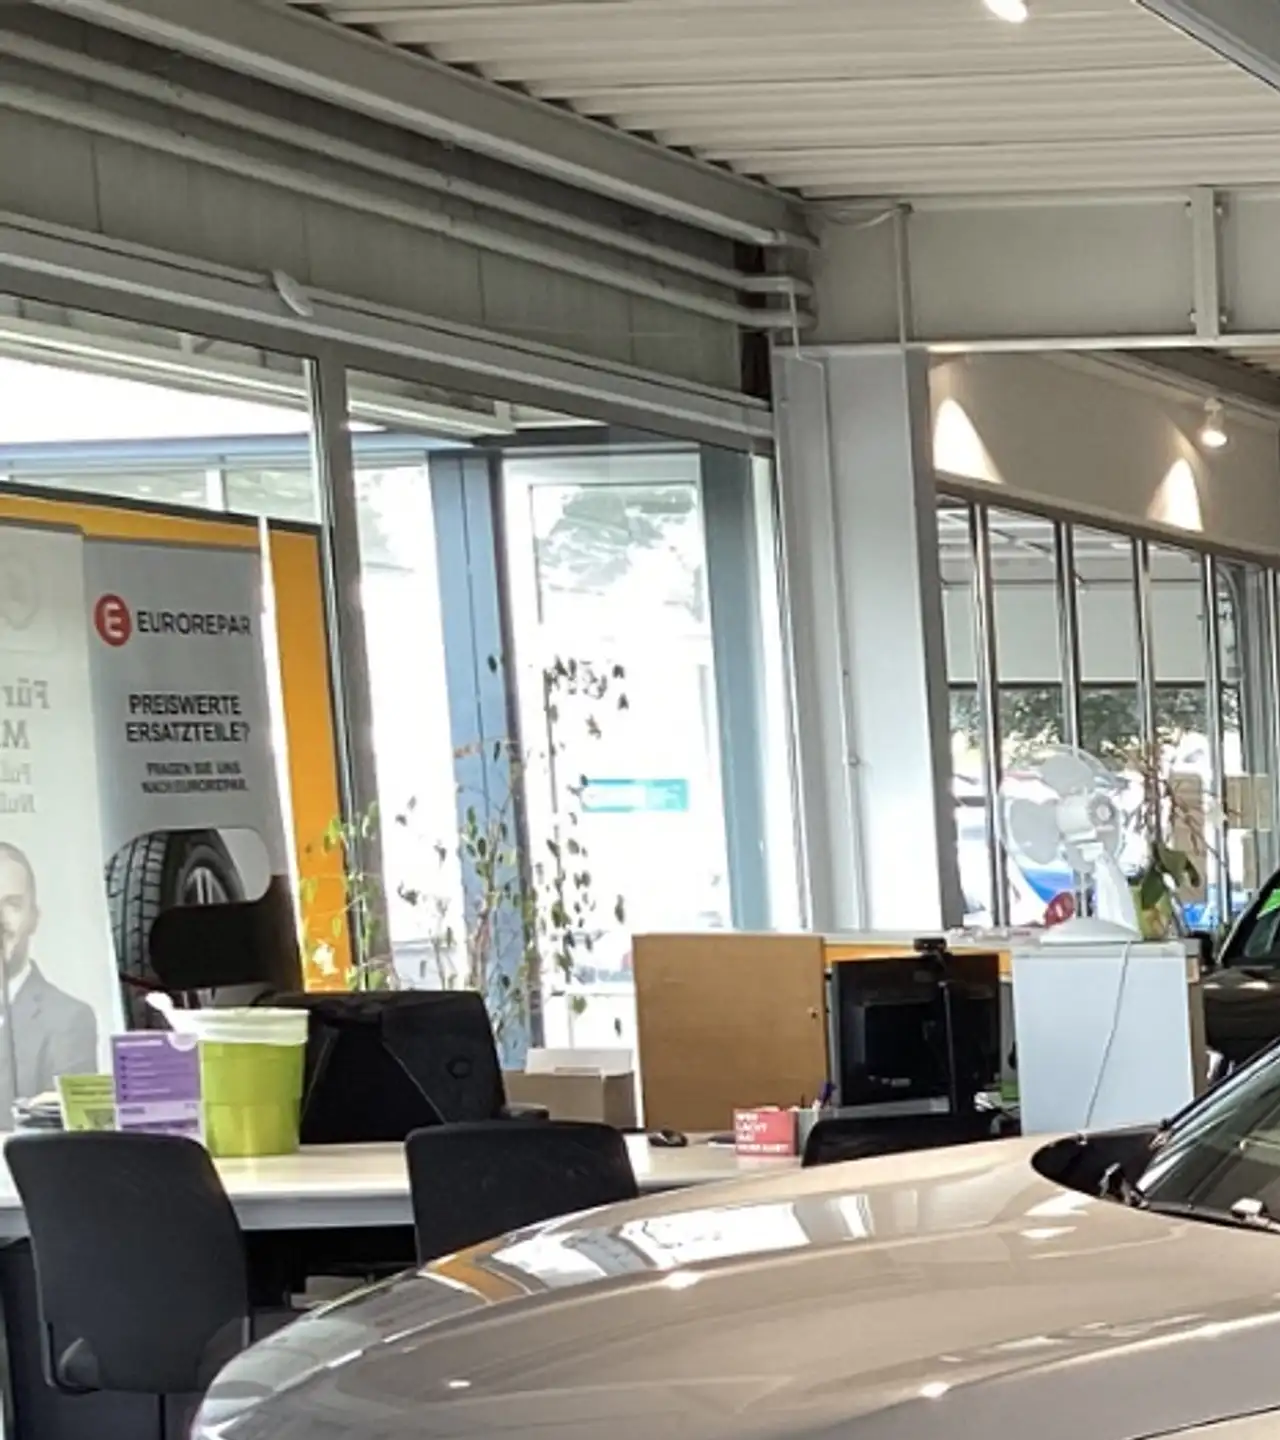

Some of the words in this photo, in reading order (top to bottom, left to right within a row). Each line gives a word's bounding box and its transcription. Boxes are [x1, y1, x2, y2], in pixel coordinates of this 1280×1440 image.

[136, 610, 253, 636] EUROREPAR
[128, 693, 242, 715] PREISWERTE
[125, 721, 250, 742] ERSATZTEILE?
